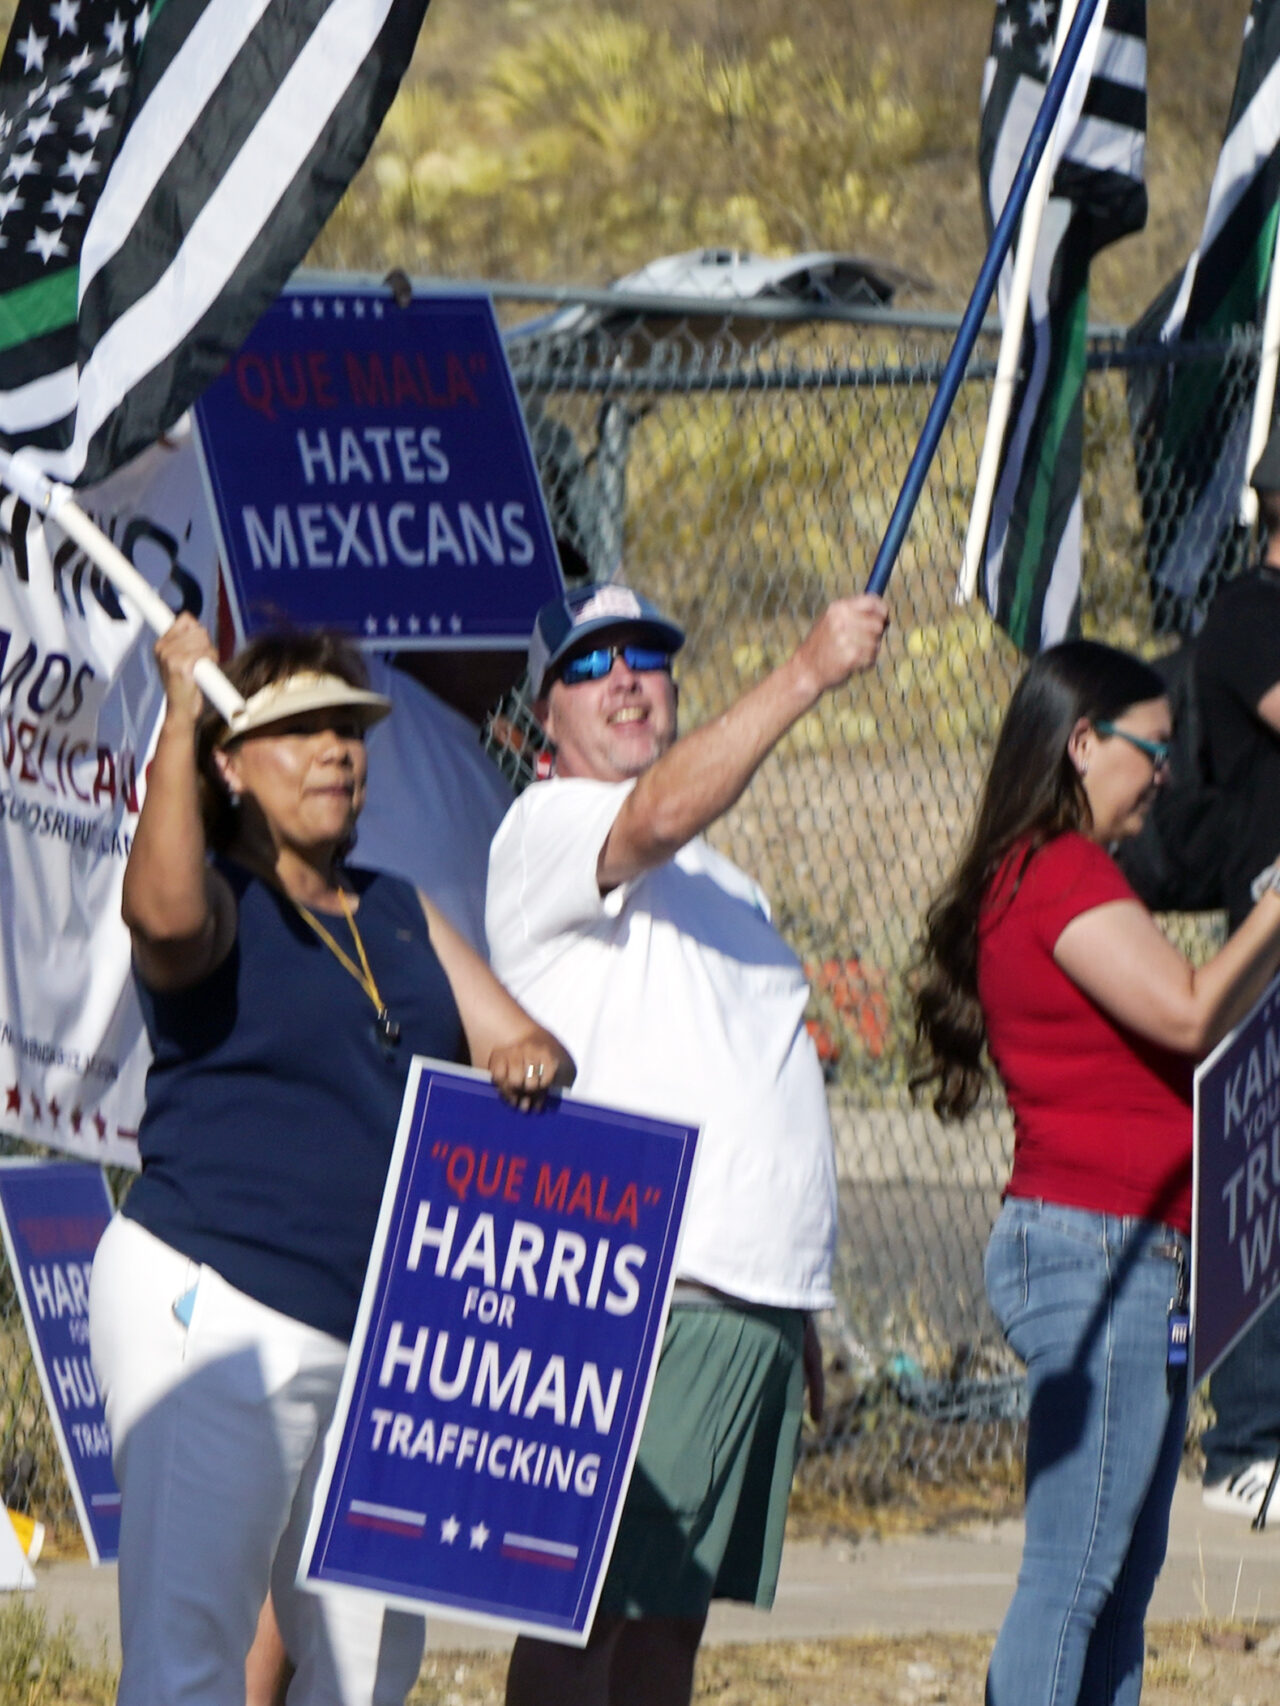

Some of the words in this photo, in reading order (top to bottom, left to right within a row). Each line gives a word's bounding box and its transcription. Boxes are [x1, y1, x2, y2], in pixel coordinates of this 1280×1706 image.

[297, 426, 450, 485] HATES
[241, 501, 536, 571] MEXICANS
[430, 1140, 527, 1201] "QUE
[533, 1162, 661, 1229] MALA"
[406, 1200, 648, 1317] HARRIS
[462, 1286, 517, 1328] FOR
[378, 1321, 623, 1436] HUMAN
[371, 1408, 602, 1498] TRAFFICKING
